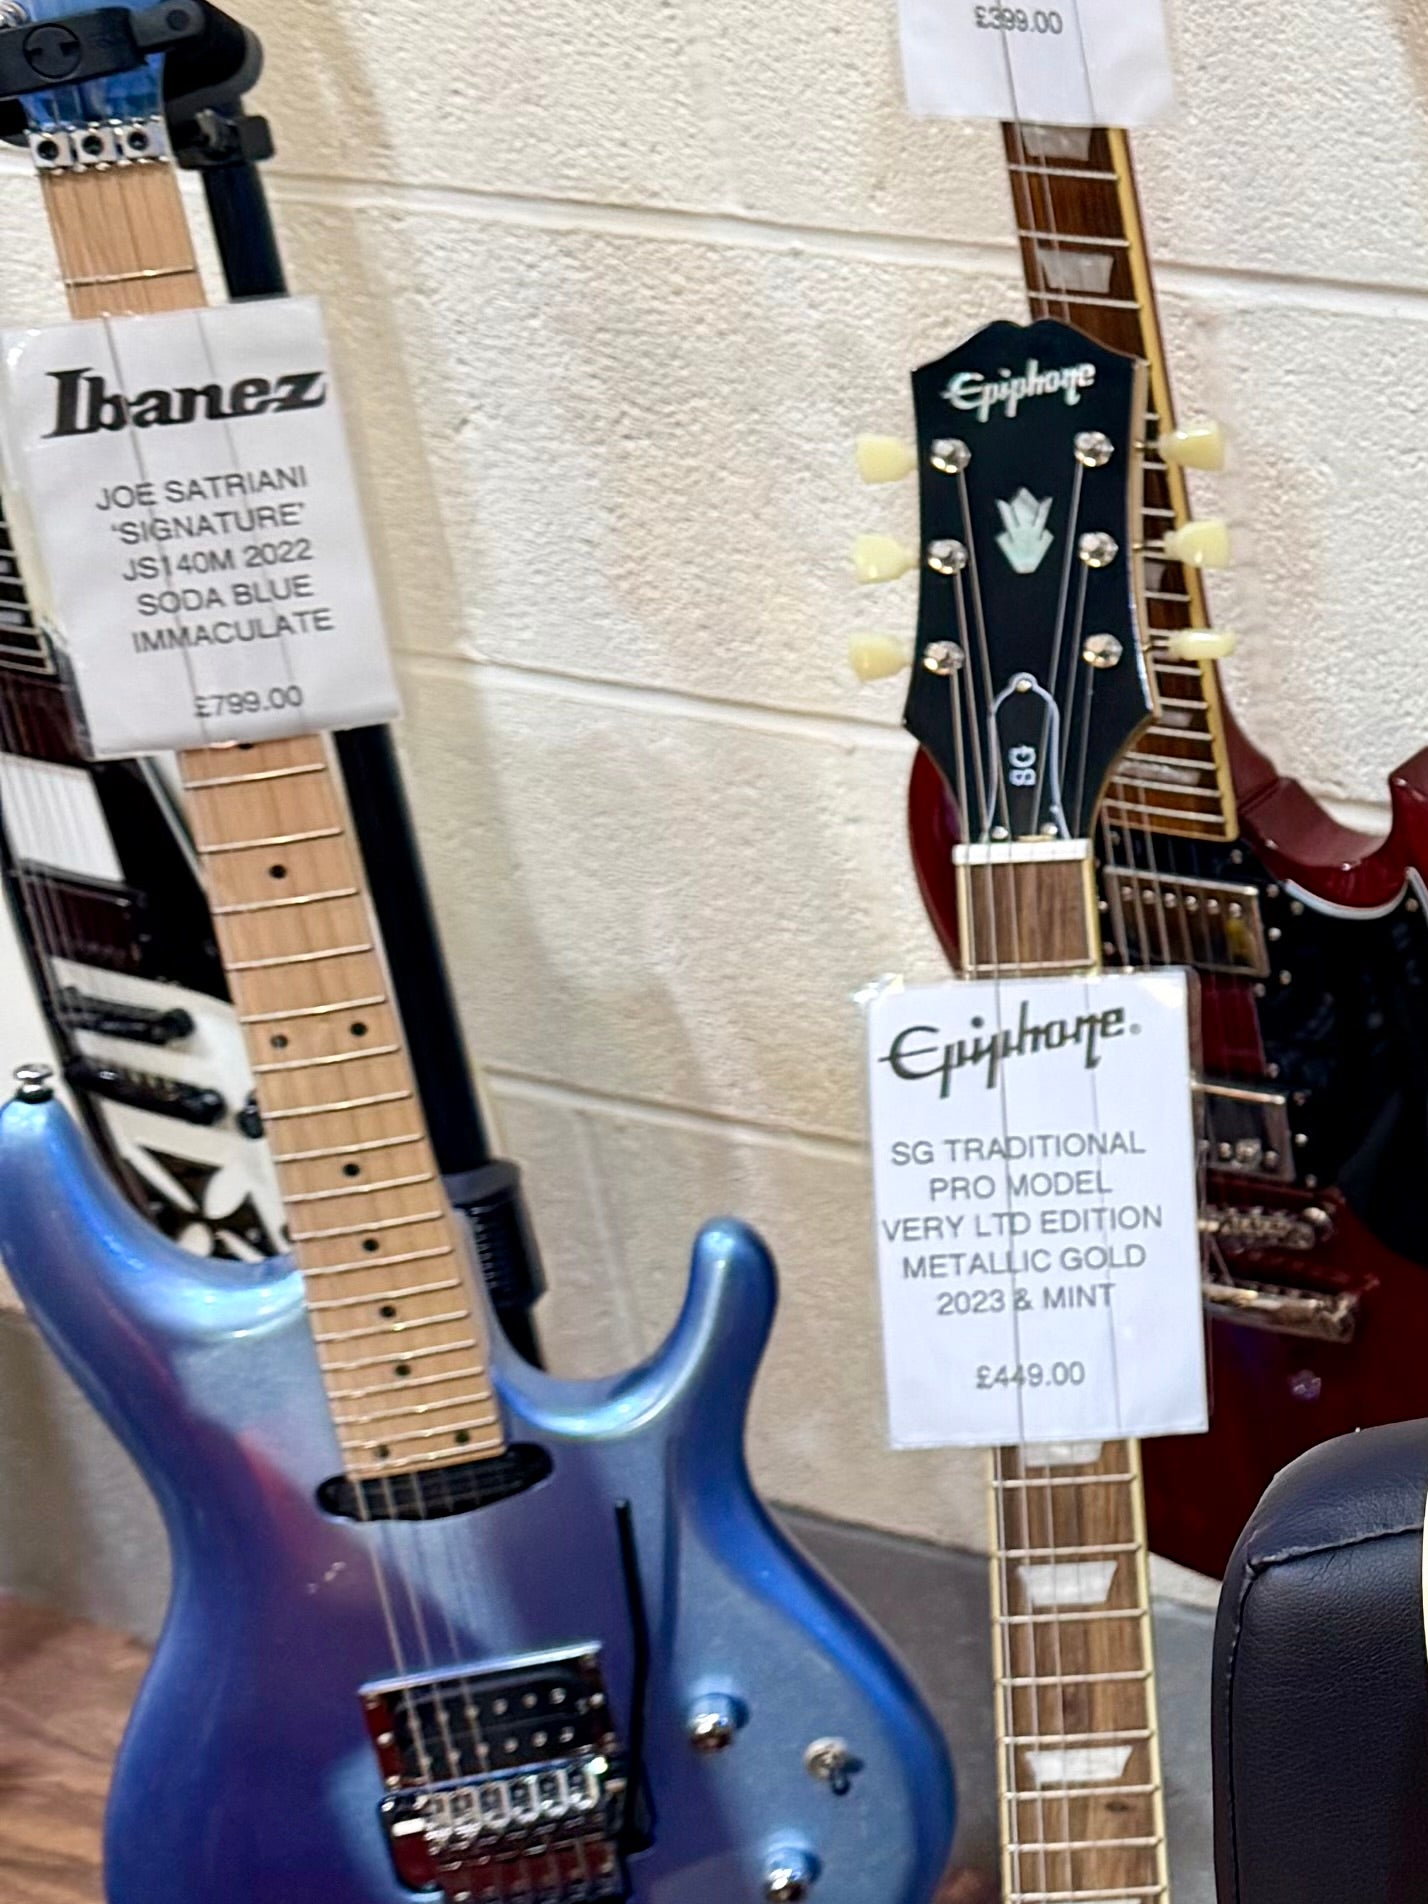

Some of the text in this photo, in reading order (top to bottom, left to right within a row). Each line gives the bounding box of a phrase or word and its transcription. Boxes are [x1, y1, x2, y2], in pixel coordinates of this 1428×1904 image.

[975, 5, 1063, 35] £399.00
[41, 367, 326, 440] Ibanez
[941, 358, 1096, 424] Epiphone
[97, 465, 309, 511] JOE SATRIANI
[123, 538, 313, 583] JS140M 2022
[138, 574, 314, 616] SODA BLUE
[133, 607, 334, 653] IMMACULATE
[194, 684, 304, 719] £799.00
[1008, 745, 1036, 788] SG
[878, 999, 1125, 1099] Epiphone
[890, 1130, 1146, 1165] SG TRADITIONAL
[929, 1168, 1112, 1202] PRO MODEL
[882, 1205, 1163, 1242] VERY LTD EDITION
[901, 1243, 1146, 1279] METALLIC GOLD
[937, 1281, 1116, 1316] 2023 & MINT
[975, 1360, 1086, 1389] £449.00
